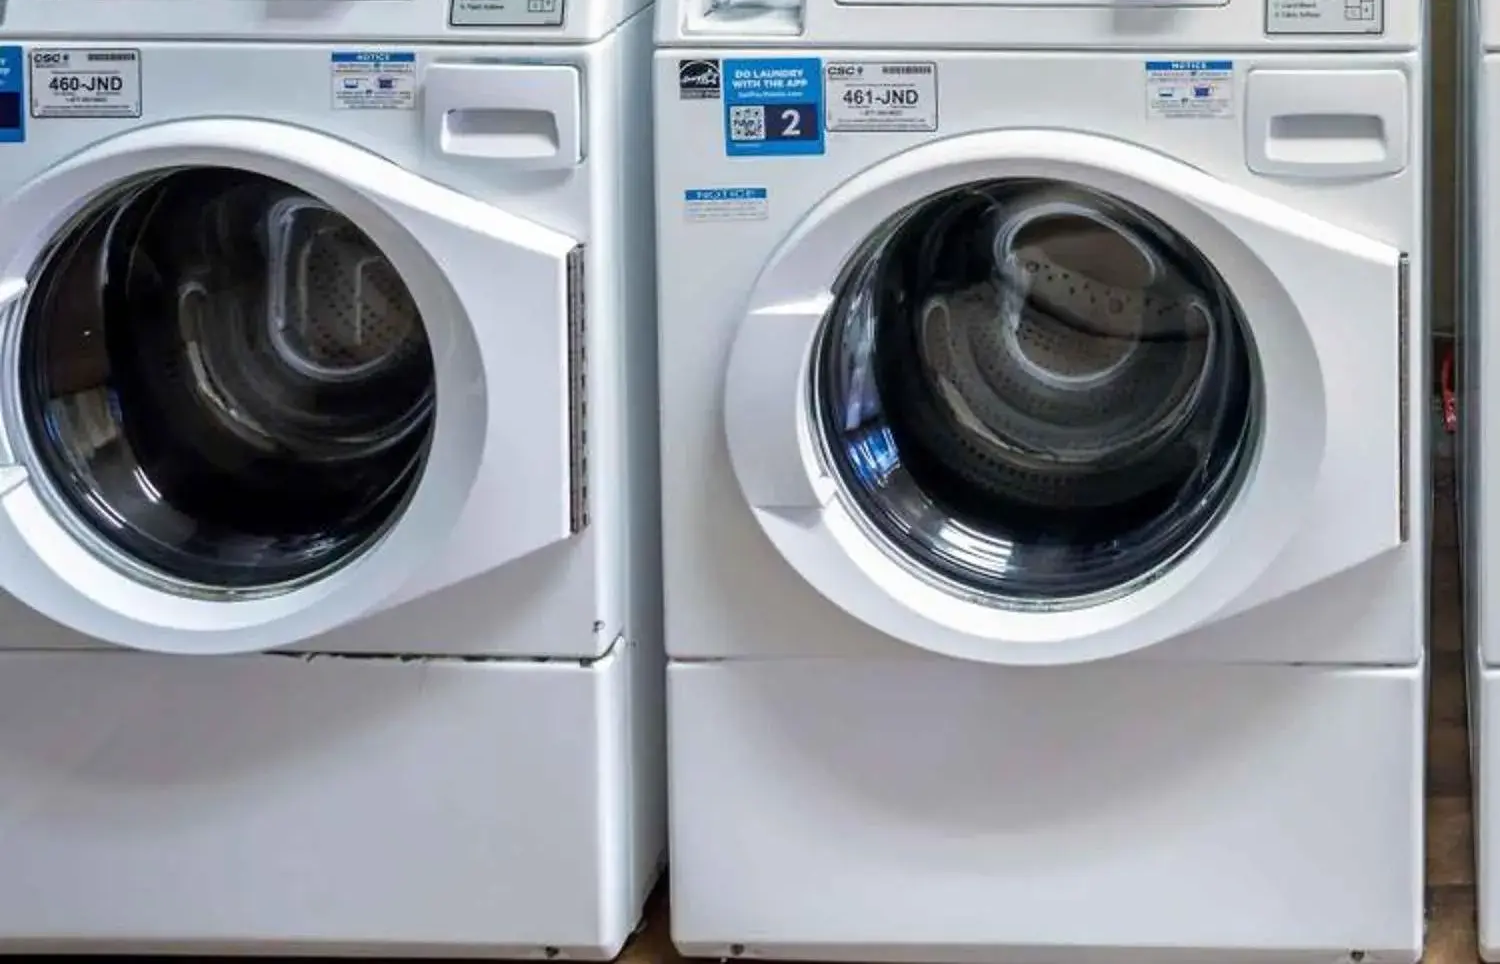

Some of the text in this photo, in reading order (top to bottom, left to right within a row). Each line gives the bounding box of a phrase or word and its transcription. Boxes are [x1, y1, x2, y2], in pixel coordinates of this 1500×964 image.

[753, 68, 804, 78] LAUNDRY
[827, 66, 856, 76] CSC
[48, 76, 123, 91] 460-JND
[732, 78, 808, 89] WITH THE APP
[842, 89, 919, 105] 461-JND
[781, 109, 801, 135] 2
